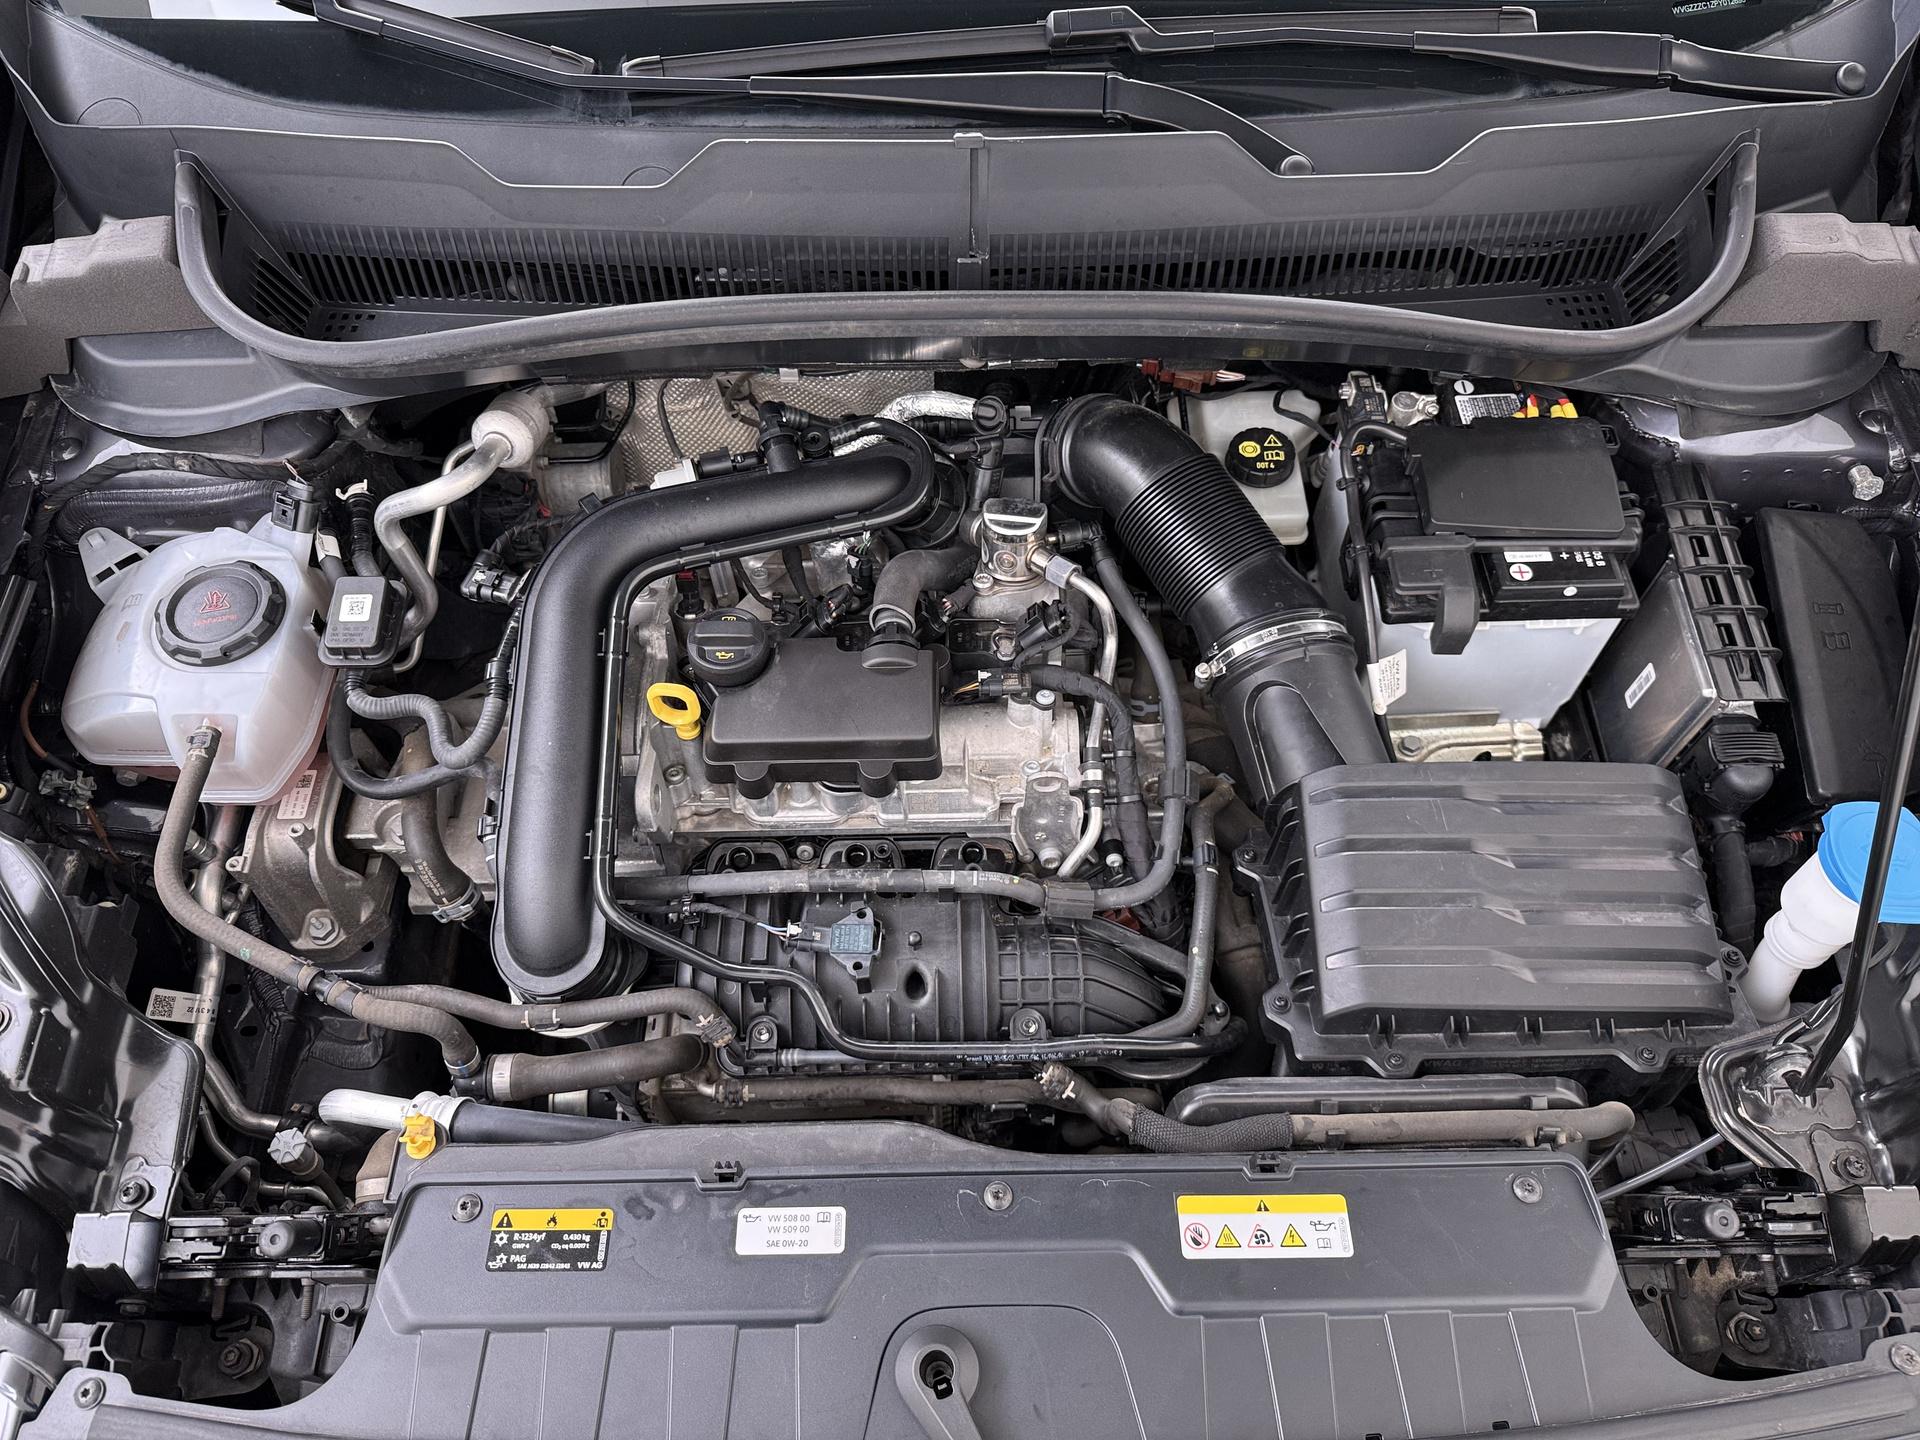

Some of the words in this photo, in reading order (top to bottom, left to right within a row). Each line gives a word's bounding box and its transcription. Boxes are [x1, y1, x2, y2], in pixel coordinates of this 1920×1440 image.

[768, 1214, 781, 1222] VW
[783, 1214, 798, 1222] 508
[799, 1214, 811, 1222] 00
[767, 1225, 781, 1233] VW
[783, 1225, 798, 1233] 509
[799, 1225, 810, 1233] 00
[513, 1232, 546, 1243] R-1234yf
[582, 1233, 591, 1242] kg
[766, 1240, 780, 1248] SAE
[782, 1239, 809, 1248] 0W-20
[509, 1254, 527, 1263] PAG
